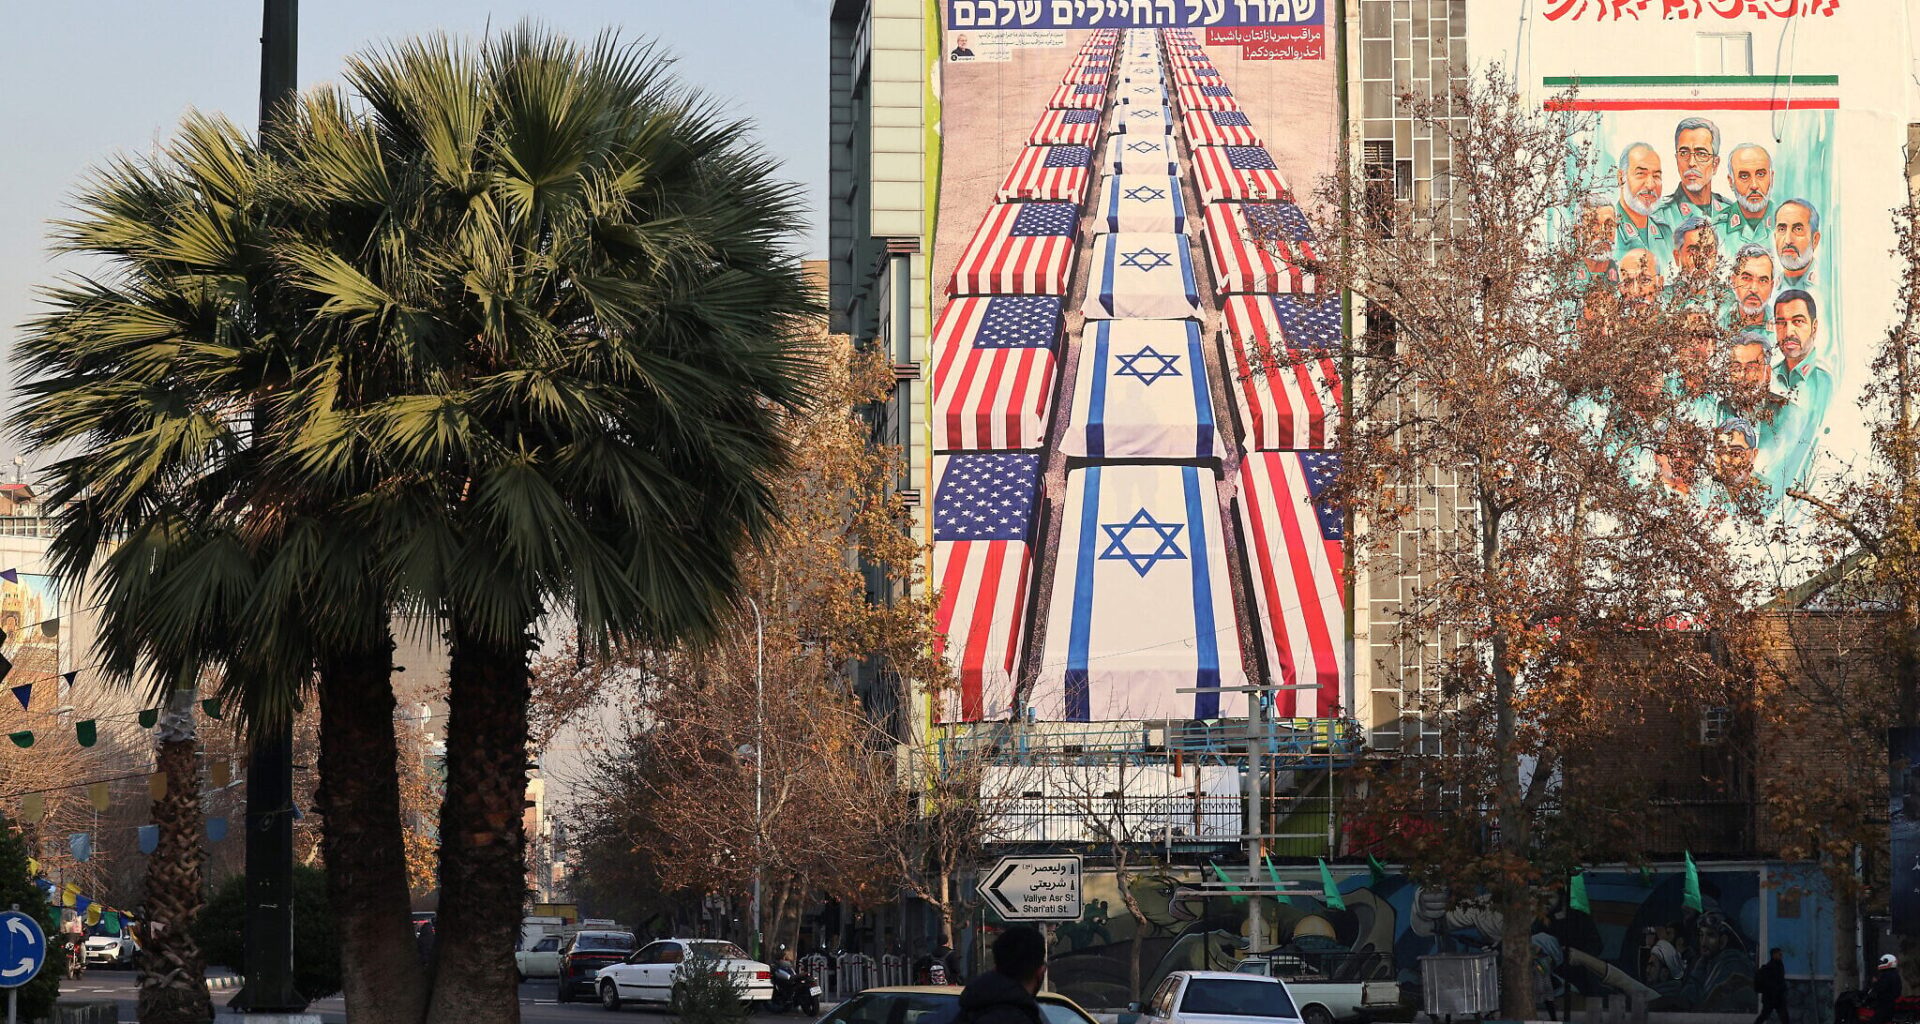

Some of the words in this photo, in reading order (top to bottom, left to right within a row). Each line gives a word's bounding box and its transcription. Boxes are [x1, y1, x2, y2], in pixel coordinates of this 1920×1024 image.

[953, 0, 1042, 26] שלכם
[1051, 0, 1176, 25] החיילים
[1184, 0, 1226, 25] על
[1234, 0, 1317, 23] שמרו
[1210, 29, 1242, 43] باشید!
[1243, 29, 1290, 43] سربازانتان
[1290, 28, 1321, 43] مراقب
[1031, 862, 1067, 875] ولیعصر
[1029, 878, 1067, 891] شریعتی
[1049, 894, 1064, 902] Asr
[1065, 894, 1076, 902] St.
[1057, 905, 1069, 913] St.
